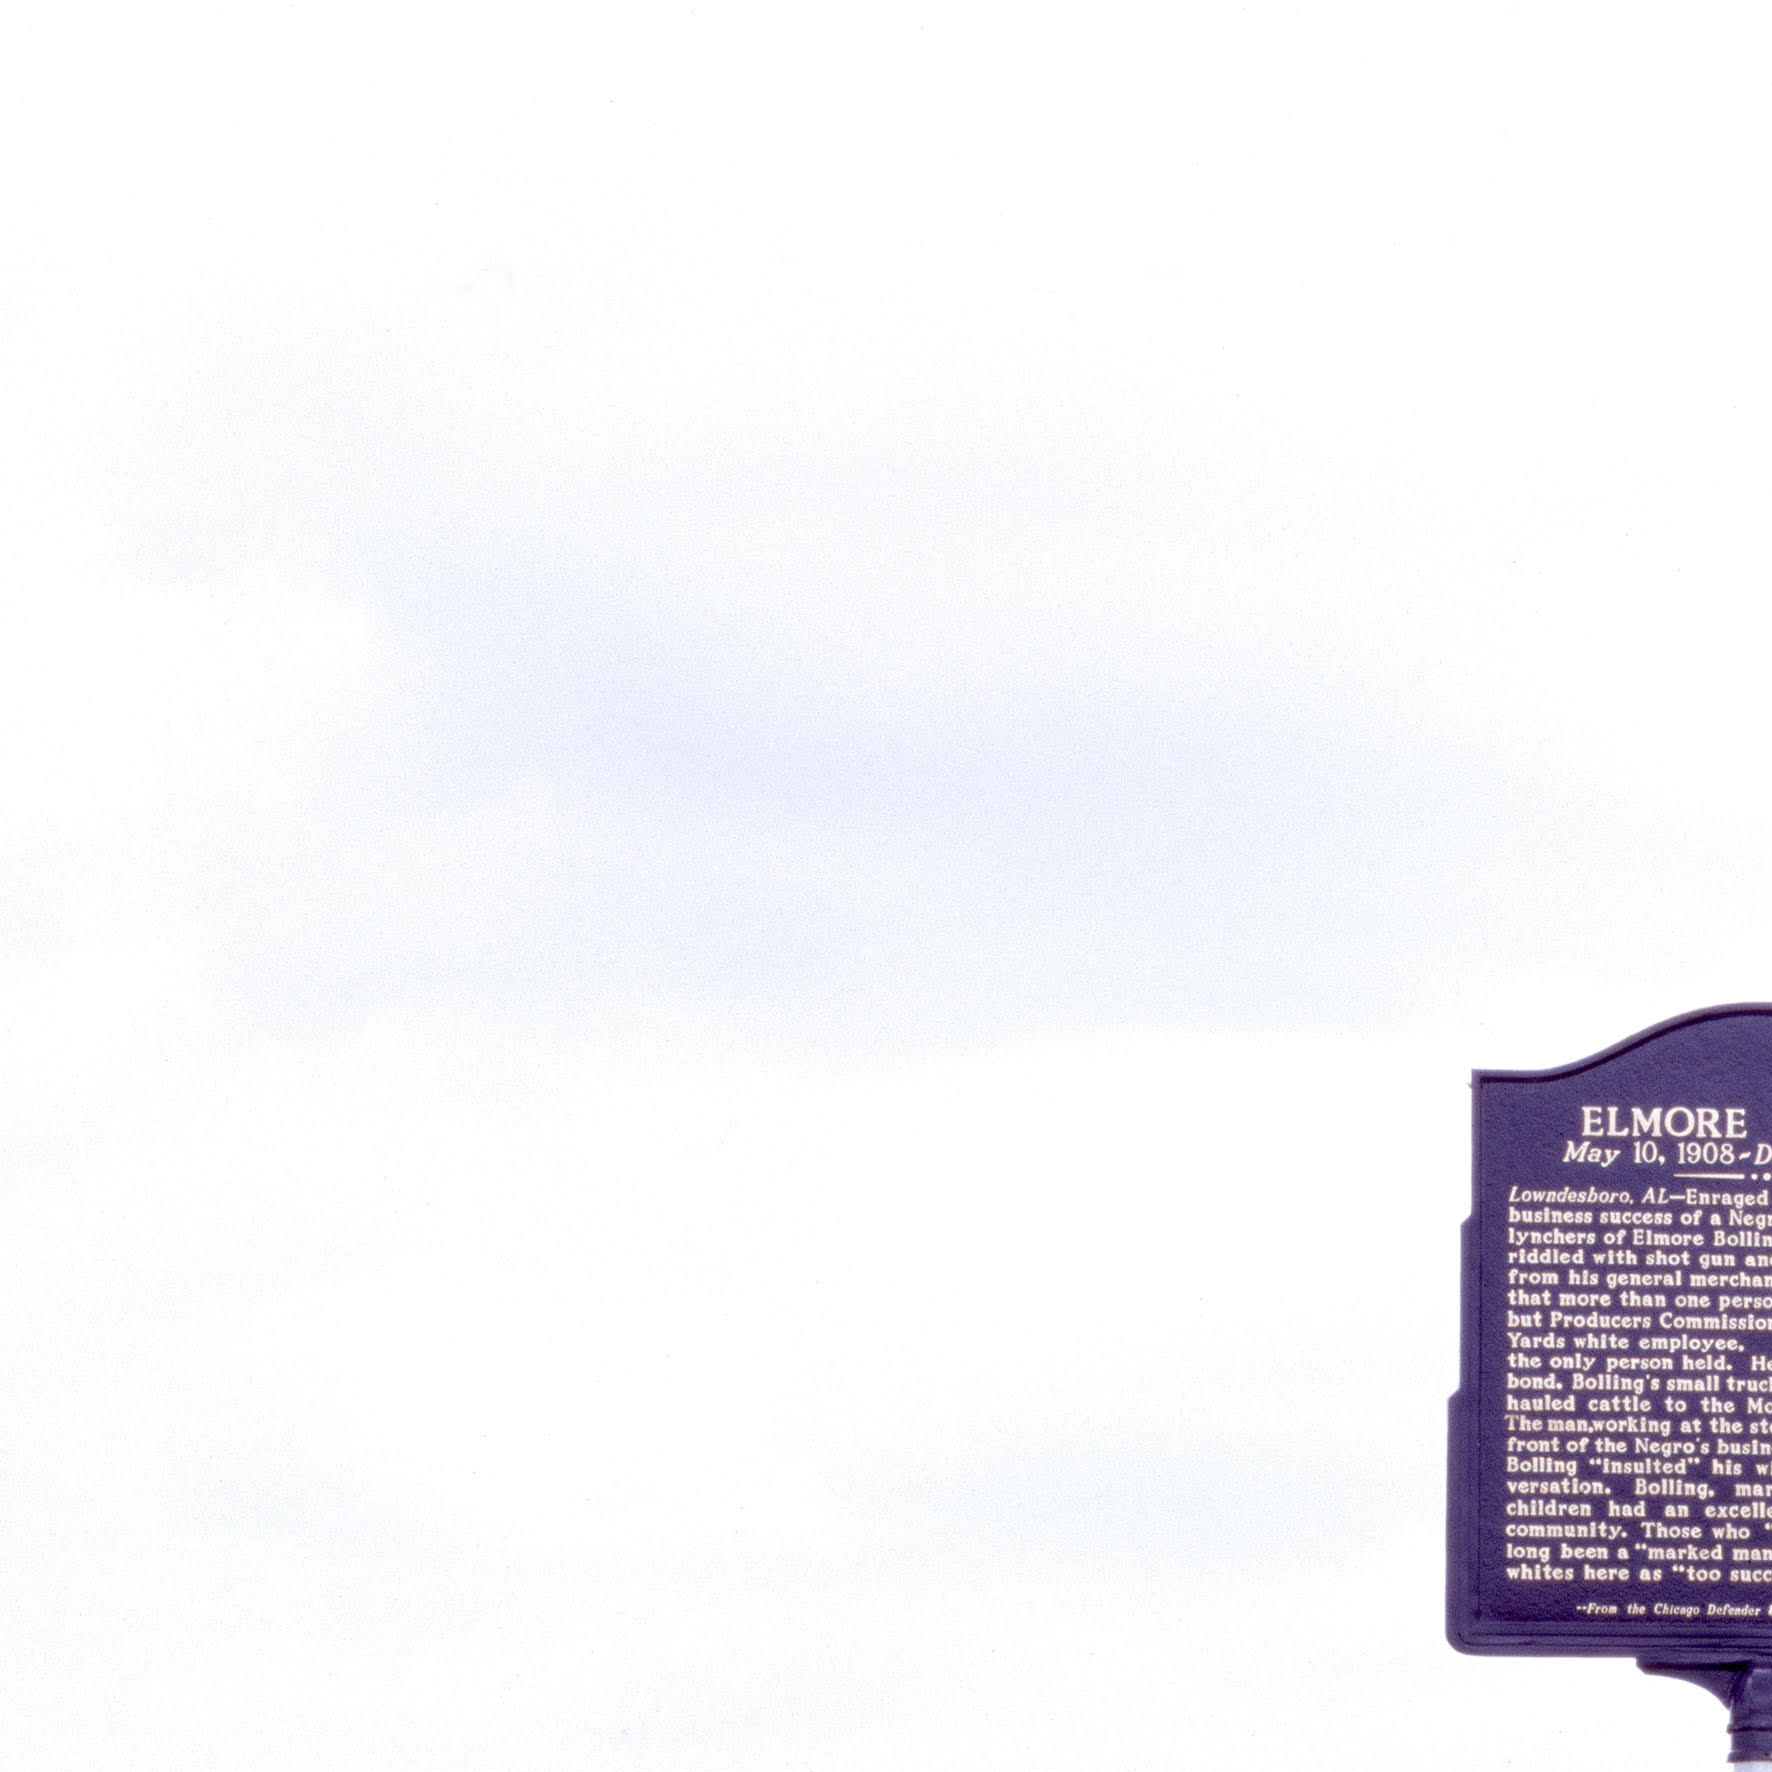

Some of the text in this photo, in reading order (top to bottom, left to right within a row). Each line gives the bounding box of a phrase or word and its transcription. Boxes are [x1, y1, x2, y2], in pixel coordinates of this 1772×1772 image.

[1581, 1105, 1748, 1139] ELMORE
[1562, 1140, 1621, 1168] May
[1633, 1140, 1666, 1166] 10,
[1509, 1206, 1593, 1224] business
[1600, 1211, 1673, 1225] success
[1681, 1209, 1703, 1226] of
[1509, 1227, 1596, 1246] lynchers
[1604, 1228, 1627, 1246] of
[1633, 1228, 1705, 1247] Elmore
[1509, 1248, 1585, 1265] riddled
[1593, 1249, 1638, 1266] with
[1646, 1249, 1691, 1266] shot
[1699, 1253, 1736, 1270] gun
[1509, 1268, 1559, 1285] from
[1569, 1268, 1599, 1286] his
[1607, 1269, 1682, 1290] general
[1508, 1288, 1552, 1306] that
[1559, 1293, 1612, 1307] more
[1620, 1289, 1667, 1308] than
[1675, 1294, 1711, 1308] one
[1508, 1309, 1543, 1328] but
[1550, 1310, 1652, 1329] Producers
[1508, 1330, 1566, 1350] Yards
[1575, 1333, 1630, 1351] white
[1508, 1352, 1543, 1369] the
[1550, 1352, 1597, 1371] only
[1607, 1357, 1674, 1373] person
[1683, 1354, 1733, 1371] held.
[1508, 1372, 1563, 1390] bond.
[1573, 1372, 1660, 1396] Bolling's
[1667, 1374, 1720, 1392] small
[1507, 1393, 1576, 1412] hauled
[1588, 1395, 1652, 1413] cattle
[1665, 1395, 1687, 1413] to
[1701, 1396, 1736, 1414] the
[1505, 1414, 1543, 1432] The
[1681, 1418, 1702, 1434] at
[1710, 1416, 1744, 1434] the
[1508, 1436, 1560, 1453] front
[1567, 1437, 1590, 1453] of
[1595, 1437, 1628, 1453] the
[1635, 1437, 1710, 1458] Negro's
[1507, 1455, 1577, 1477] Bolling
[1712, 1458, 1742, 1476] his
[1507, 1477, 1611, 1495] versation.
[1635, 1477, 1715, 1500] Bolling,
[1507, 1498, 1592, 1517] children
[1609, 1499, 1646, 1517] had
[1665, 1504, 1689, 1518] an
[1506, 1521, 1628, 1540] community.
[1641, 1521, 1702, 1539] Those
[1713, 1522, 1751, 1540] who
[1507, 1543, 1550, 1564] long
[1561, 1542, 1609, 1560] been
[1507, 1563, 1574, 1581] whites
[1584, 1564, 1630, 1581] here
[1654, 1602, 1700, 1618] Chicago
[1708, 1603, 1761, 1616] Defender
